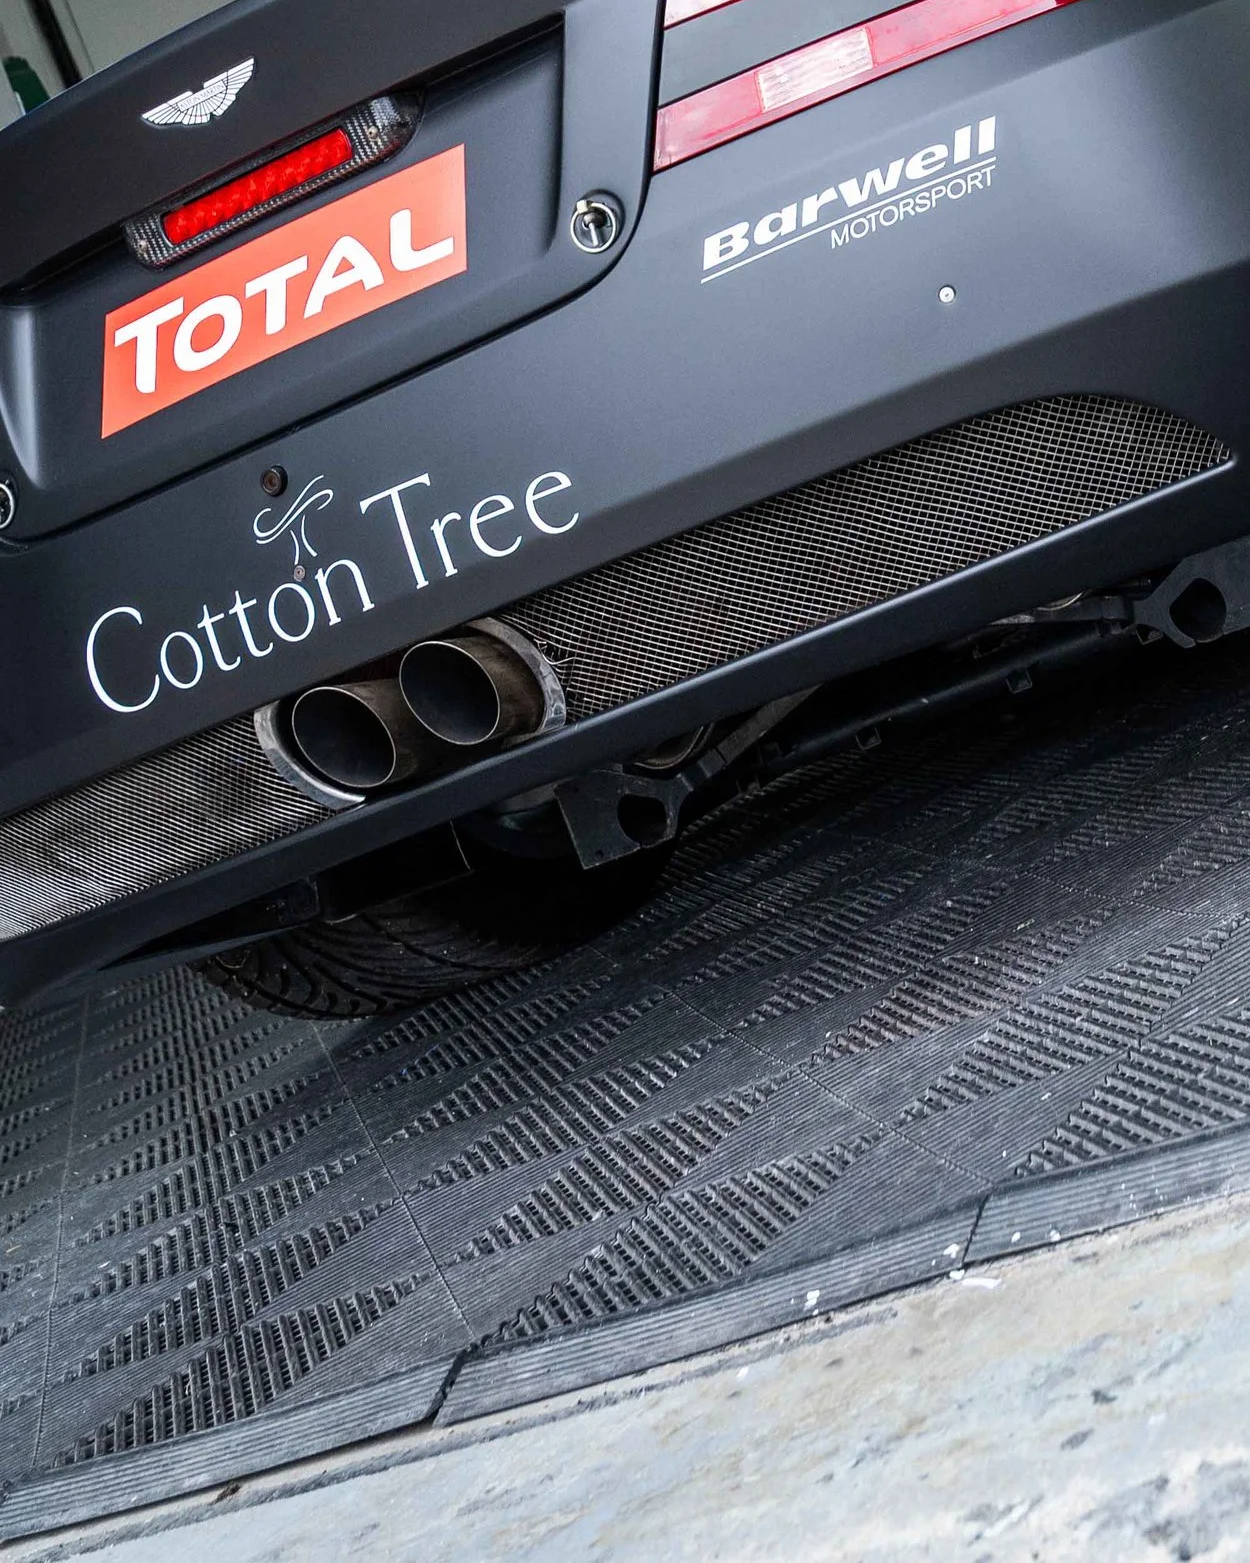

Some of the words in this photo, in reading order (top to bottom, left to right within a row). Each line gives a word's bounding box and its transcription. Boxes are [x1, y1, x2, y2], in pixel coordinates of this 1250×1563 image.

[702, 115, 997, 271] Barwell
[830, 165, 997, 250] MOTORSPORT
[114, 207, 456, 394] TOTAL
[86, 559, 376, 714] Cotton
[359, 471, 580, 590] Tree
